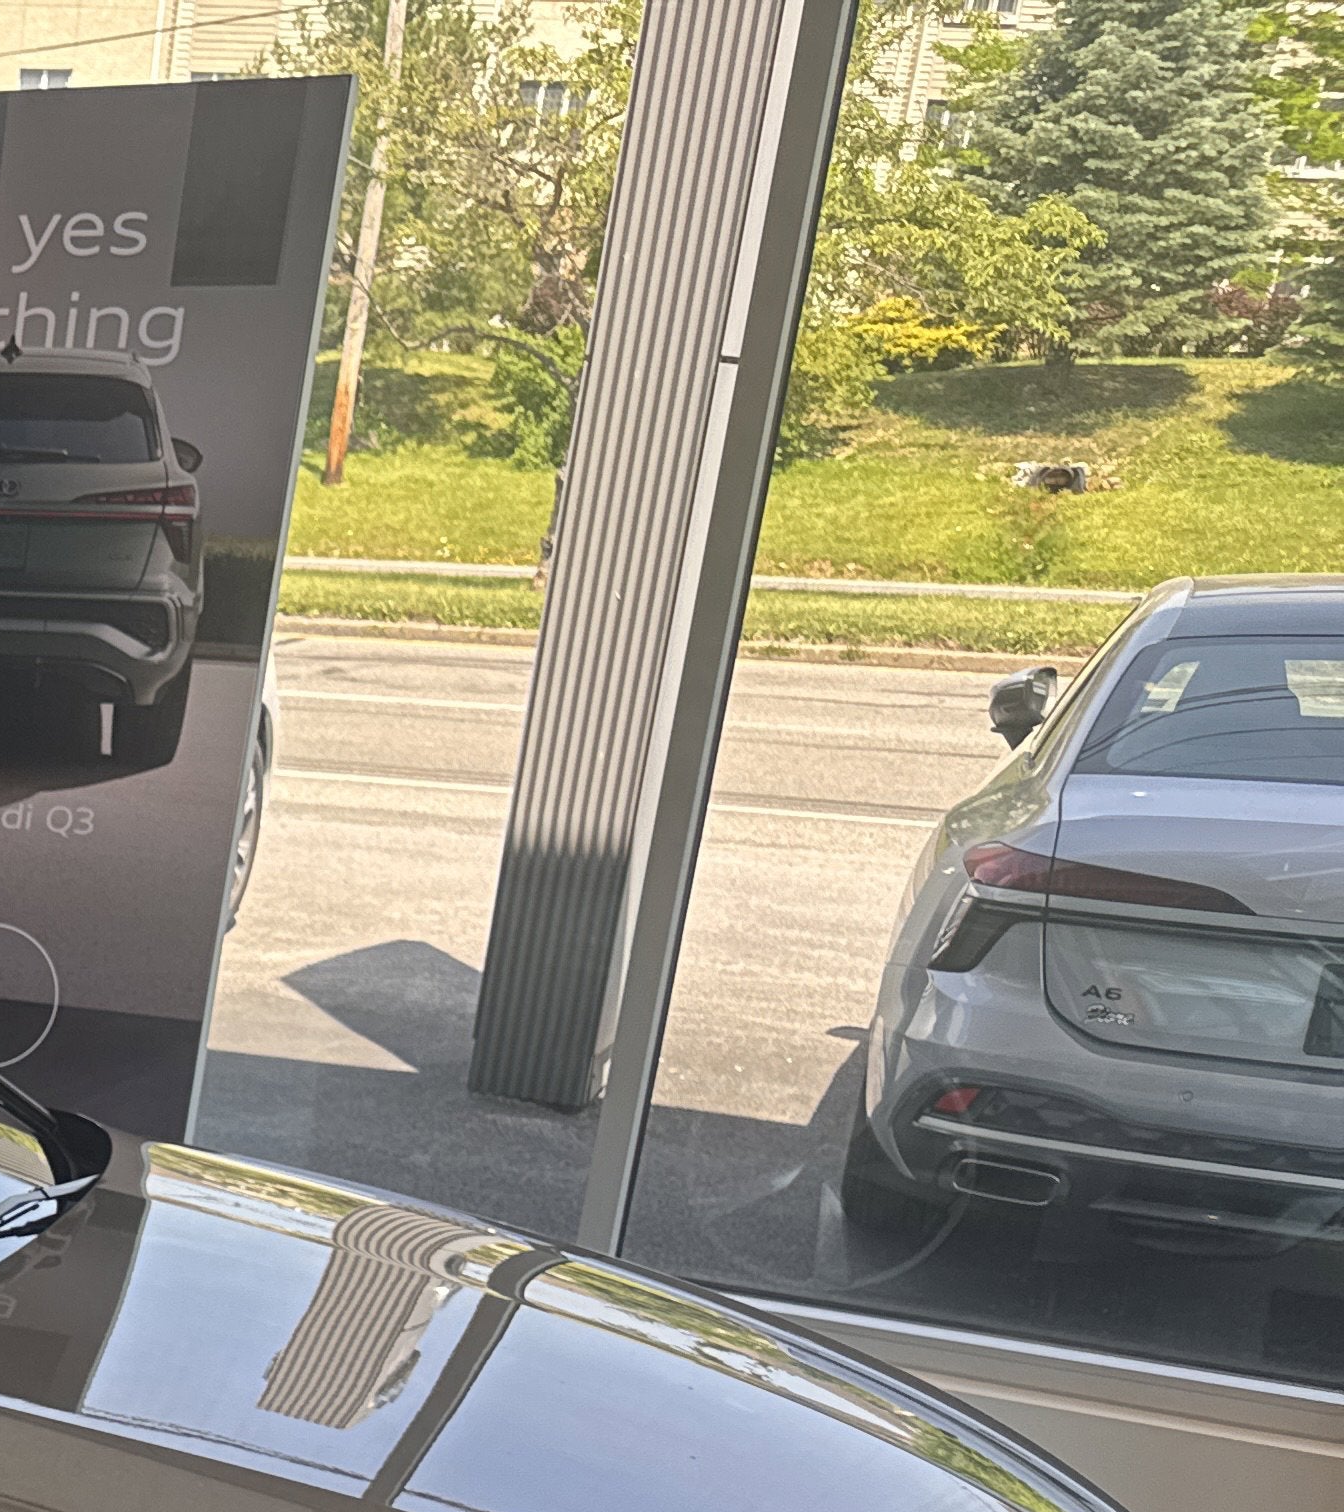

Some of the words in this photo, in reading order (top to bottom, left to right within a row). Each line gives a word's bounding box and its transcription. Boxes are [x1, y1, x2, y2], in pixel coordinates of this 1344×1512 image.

[12, 209, 149, 274] yes
[45, 804, 95, 838] Q3
[1081, 985, 1123, 1001] A6
